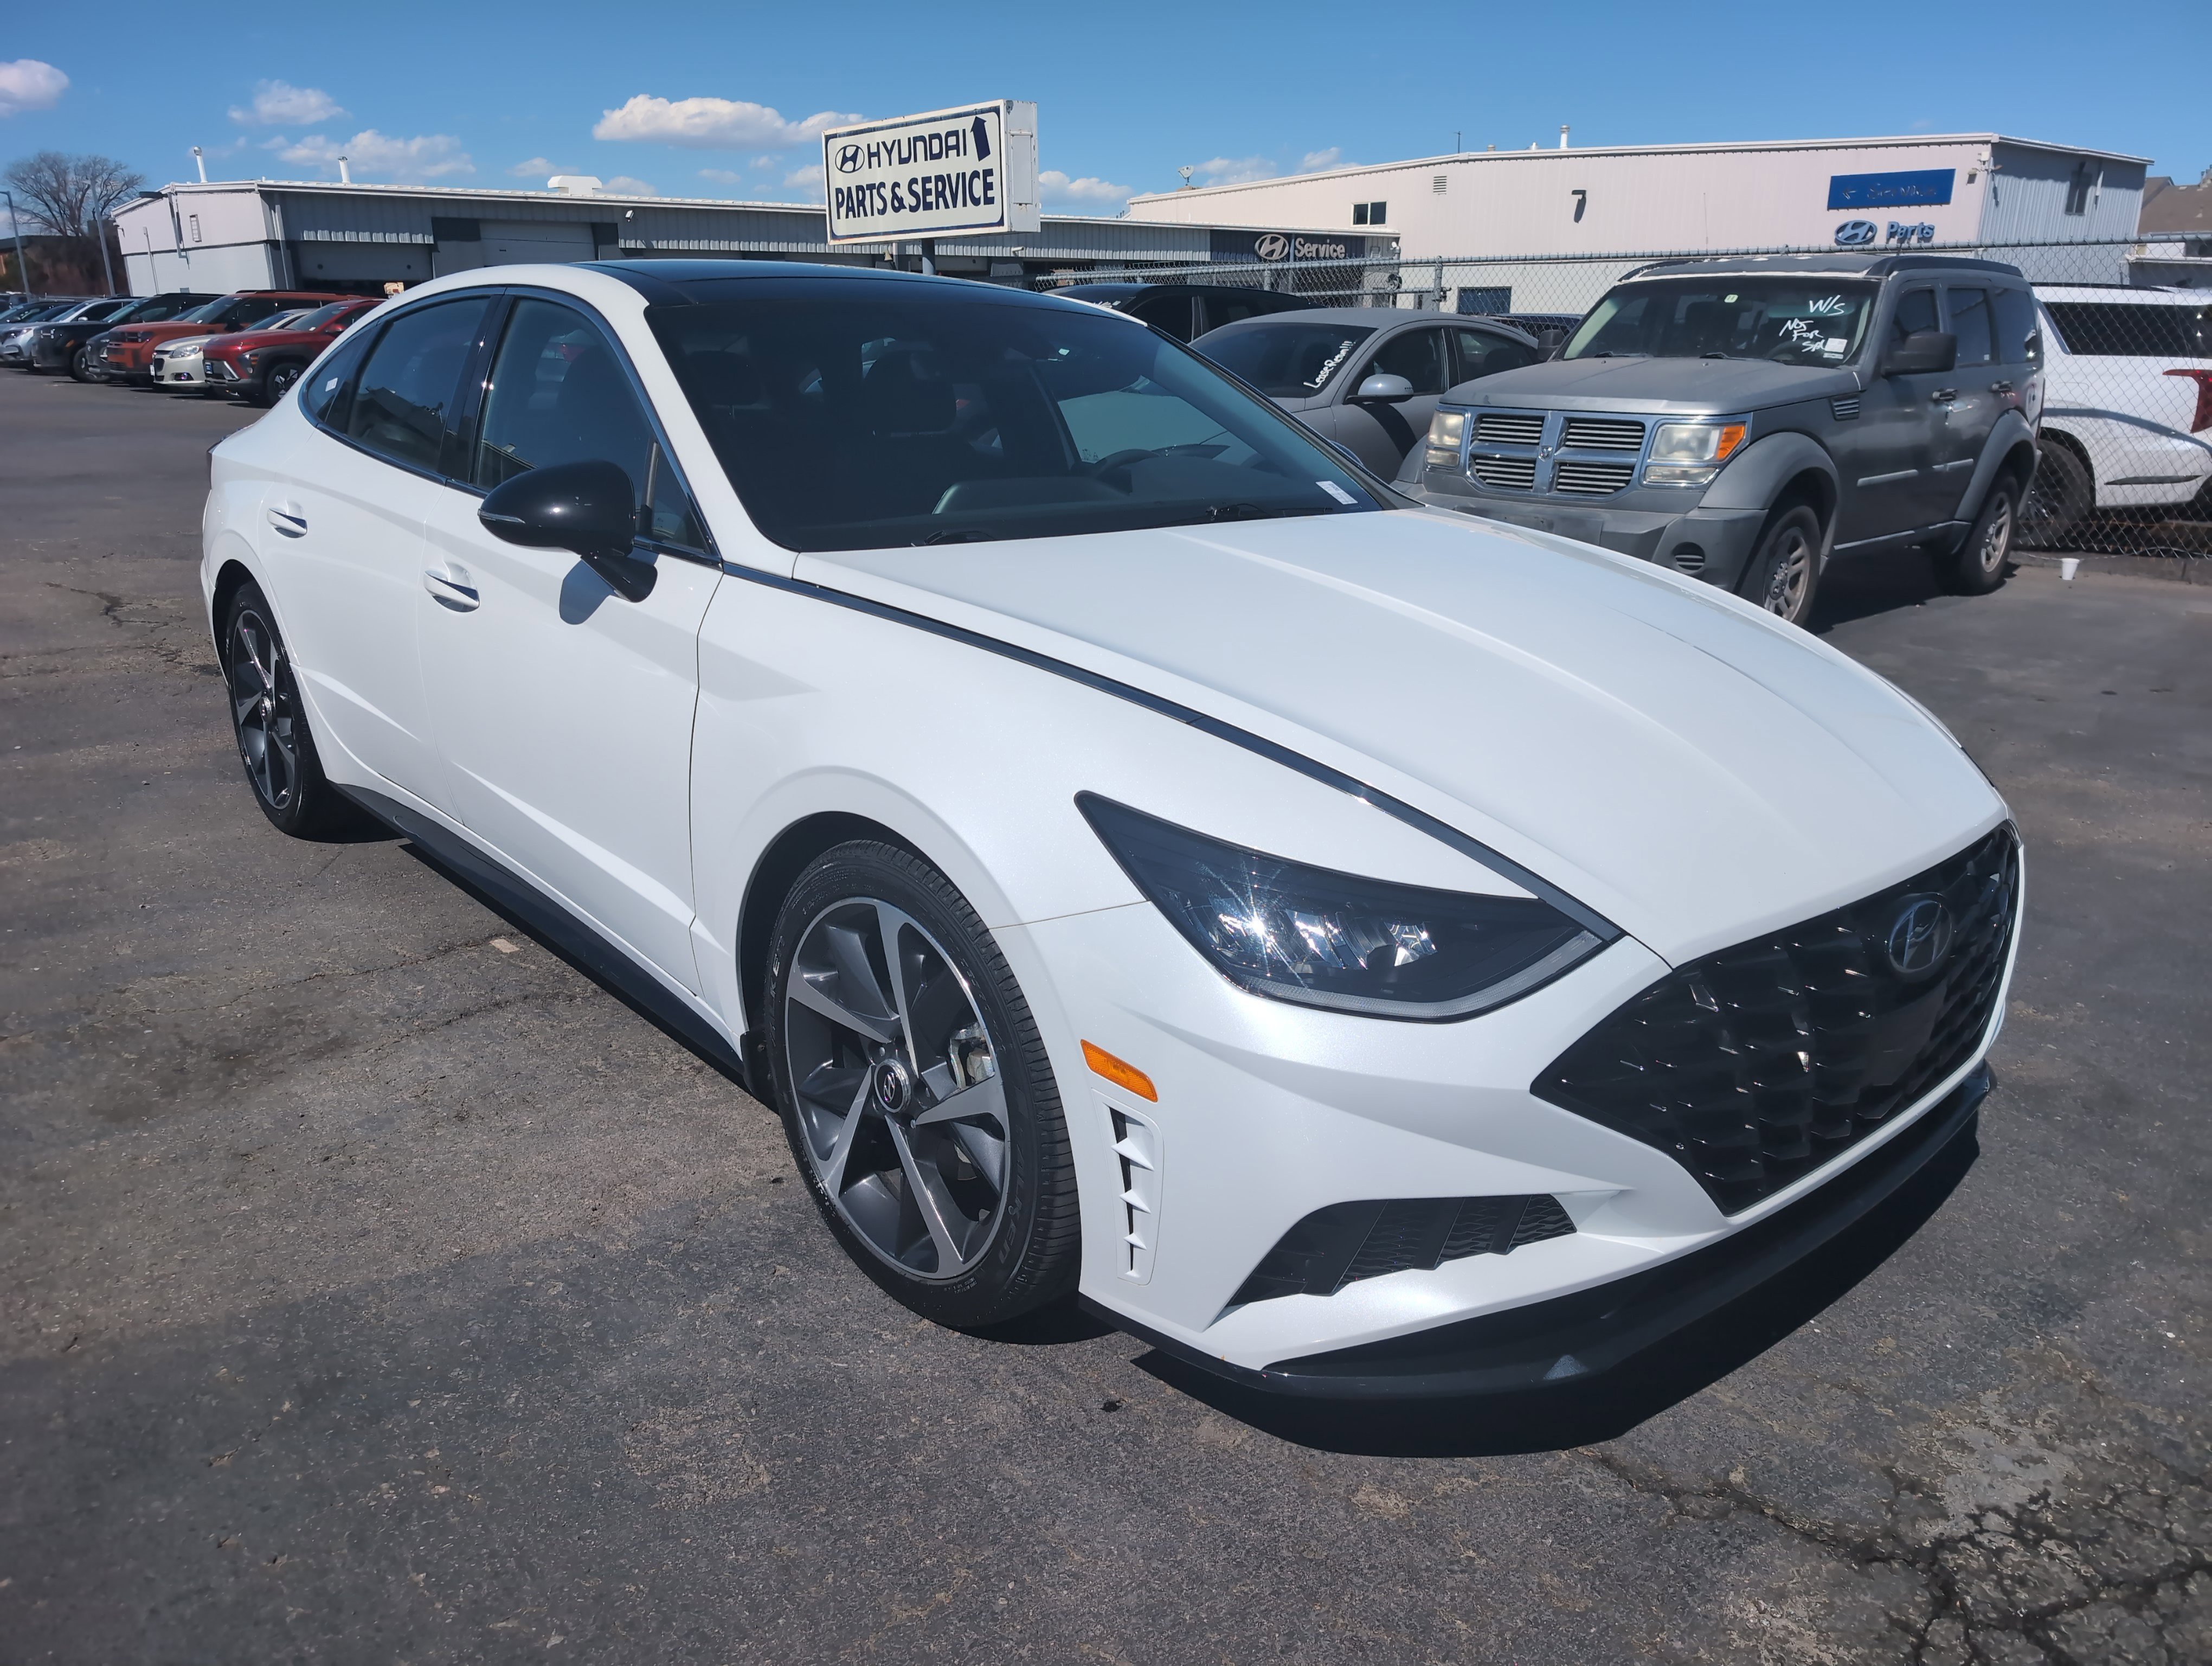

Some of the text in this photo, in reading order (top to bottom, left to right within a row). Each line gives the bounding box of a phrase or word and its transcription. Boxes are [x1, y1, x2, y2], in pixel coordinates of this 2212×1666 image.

[867, 129, 967, 169] HYUNDAI
[1886, 221, 1935, 239] Parts
[1295, 238, 1346, 258] Service
[1809, 294, 1846, 316] W/S
